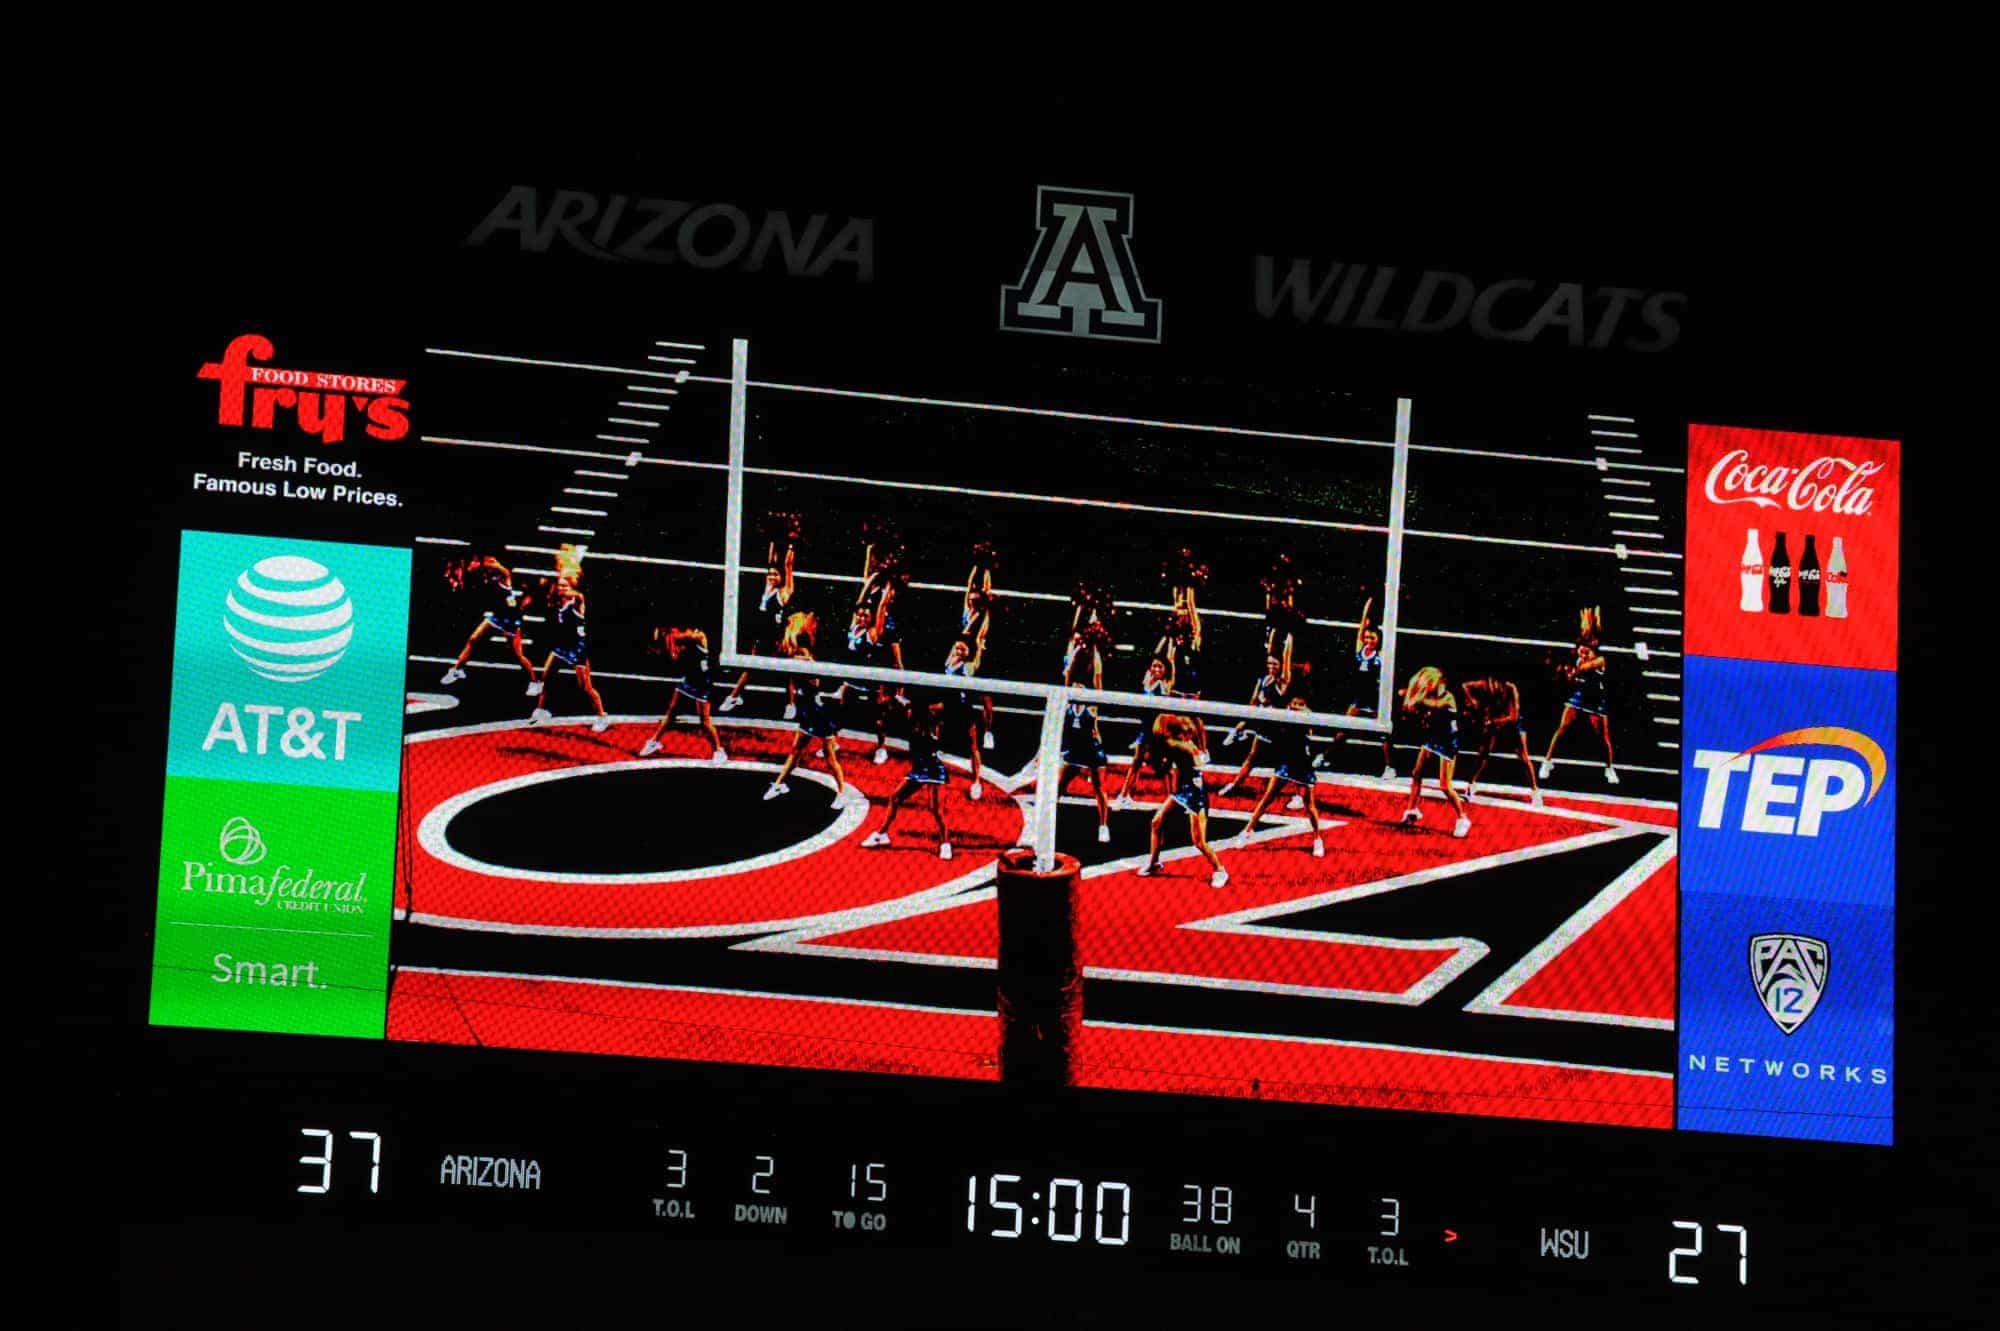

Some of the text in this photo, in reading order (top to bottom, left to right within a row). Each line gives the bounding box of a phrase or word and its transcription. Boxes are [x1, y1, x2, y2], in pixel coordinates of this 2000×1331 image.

[461, 185, 876, 283] ARIZONA
[1000, 185, 1162, 344] A
[1252, 254, 1689, 352] WILDCATS
[251, 367, 397, 394] FOOD STORES
[238, 452, 362, 478] Fresh Food.
[1705, 450, 1885, 516] Coca-Cola
[193, 473, 403, 507] Famous Low Prices.
[202, 702, 363, 761] AT&T
[1693, 749, 1867, 837] TEP
[276, 900, 323, 912] CREDIT
[211, 952, 328, 990] Smart.
[1753, 938, 1828, 990] PAC
[1774, 986, 1804, 1014] 12
[1689, 1054, 1888, 1085] NETWORKS
[298, 1127, 381, 1194] 37
[440, 1155, 541, 1190] ARIZONA
[666, 1149, 687, 1188] 3
[752, 1155, 774, 1194] 2
[850, 1163, 886, 1201] 15
[734, 1203, 787, 1224] DOWN
[832, 1210, 887, 1231] TO GO
[967, 1174, 1131, 1246] 15:00
[1183, 1184, 1232, 1225] 38
[1294, 1194, 1316, 1229] 4
[1380, 1198, 1400, 1236] 3
[1169, 1233, 1241, 1255] BALL ON
[1286, 1240, 1321, 1260] QTR
[1541, 1228, 1589, 1260] WSU
[1669, 1220, 1747, 1286] 27
